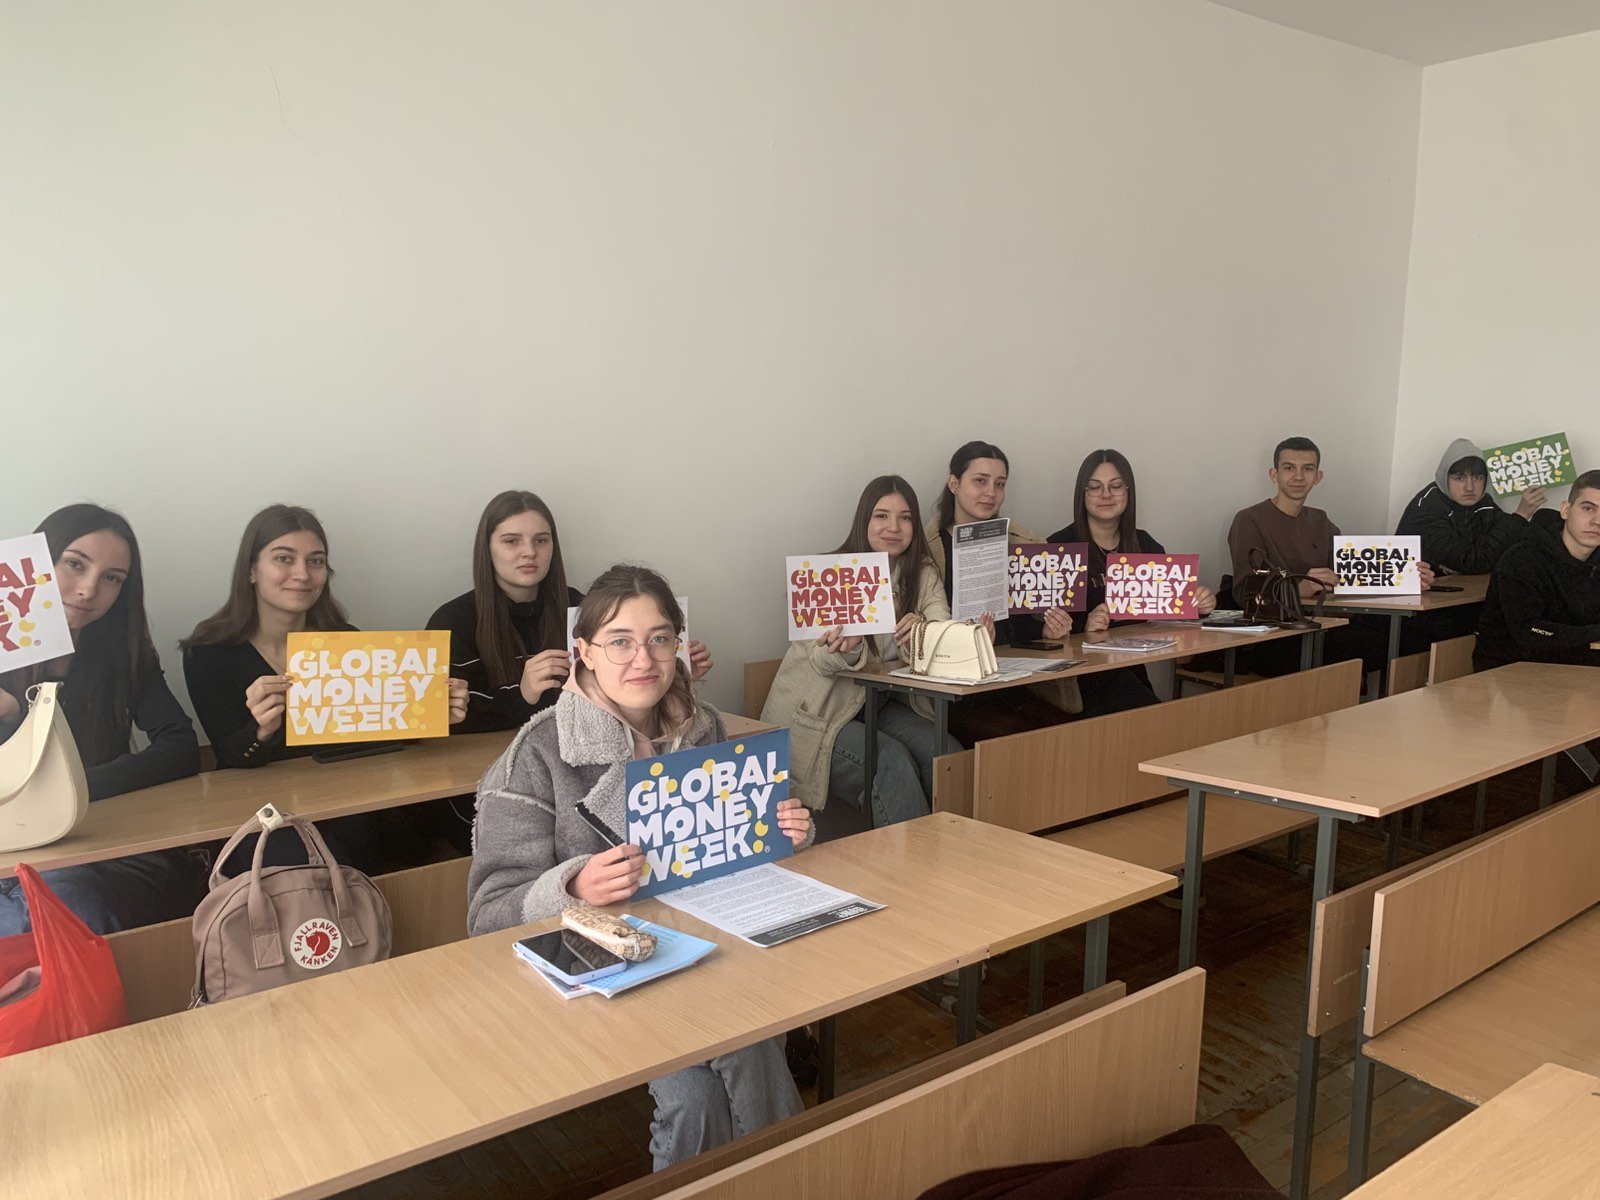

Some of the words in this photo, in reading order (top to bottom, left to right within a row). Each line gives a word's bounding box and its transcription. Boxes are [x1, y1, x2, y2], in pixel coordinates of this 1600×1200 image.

[1486, 442, 1569, 469] GLOBAL
[1489, 455, 1562, 483] MONEY
[1492, 470, 1555, 495] WEEK
[1008, 554, 1087, 573] GLOBAL
[1336, 548, 1415, 561] GLOBAL
[791, 566, 888, 589] GLOBAL
[1107, 564, 1197, 581] GLOBAL
[1336, 561, 1408, 574] MONEY
[1008, 571, 1079, 590] MONEY
[1106, 580, 1188, 597] MONEY
[1336, 573, 1395, 587] WEEK
[792, 585, 880, 608] MONEY
[1008, 589, 1066, 609] WEEK
[1105, 597, 1174, 614] WEEK
[792, 605, 867, 628] WEEK
[289, 648, 448, 679] GLOBAL
[289, 675, 434, 707] MONEY
[288, 703, 409, 736] WEEK
[628, 751, 788, 816] GLOBAL
[629, 784, 774, 848] MONEY
